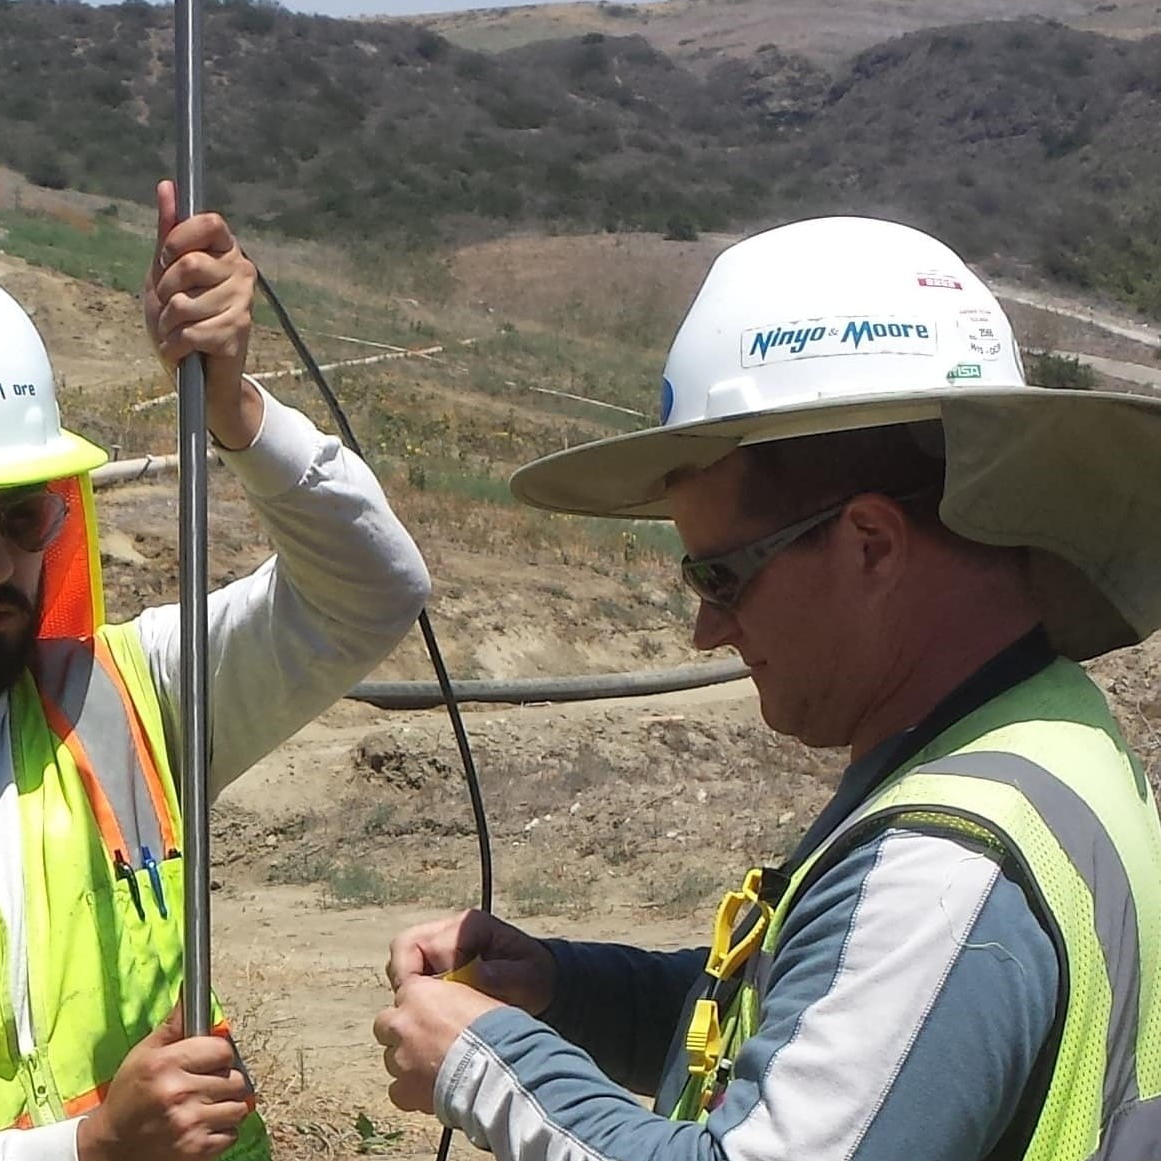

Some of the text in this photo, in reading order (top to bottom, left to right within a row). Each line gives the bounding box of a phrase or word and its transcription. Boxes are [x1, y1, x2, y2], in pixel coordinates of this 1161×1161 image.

[749, 320, 929, 360] Ninyo & Moore
